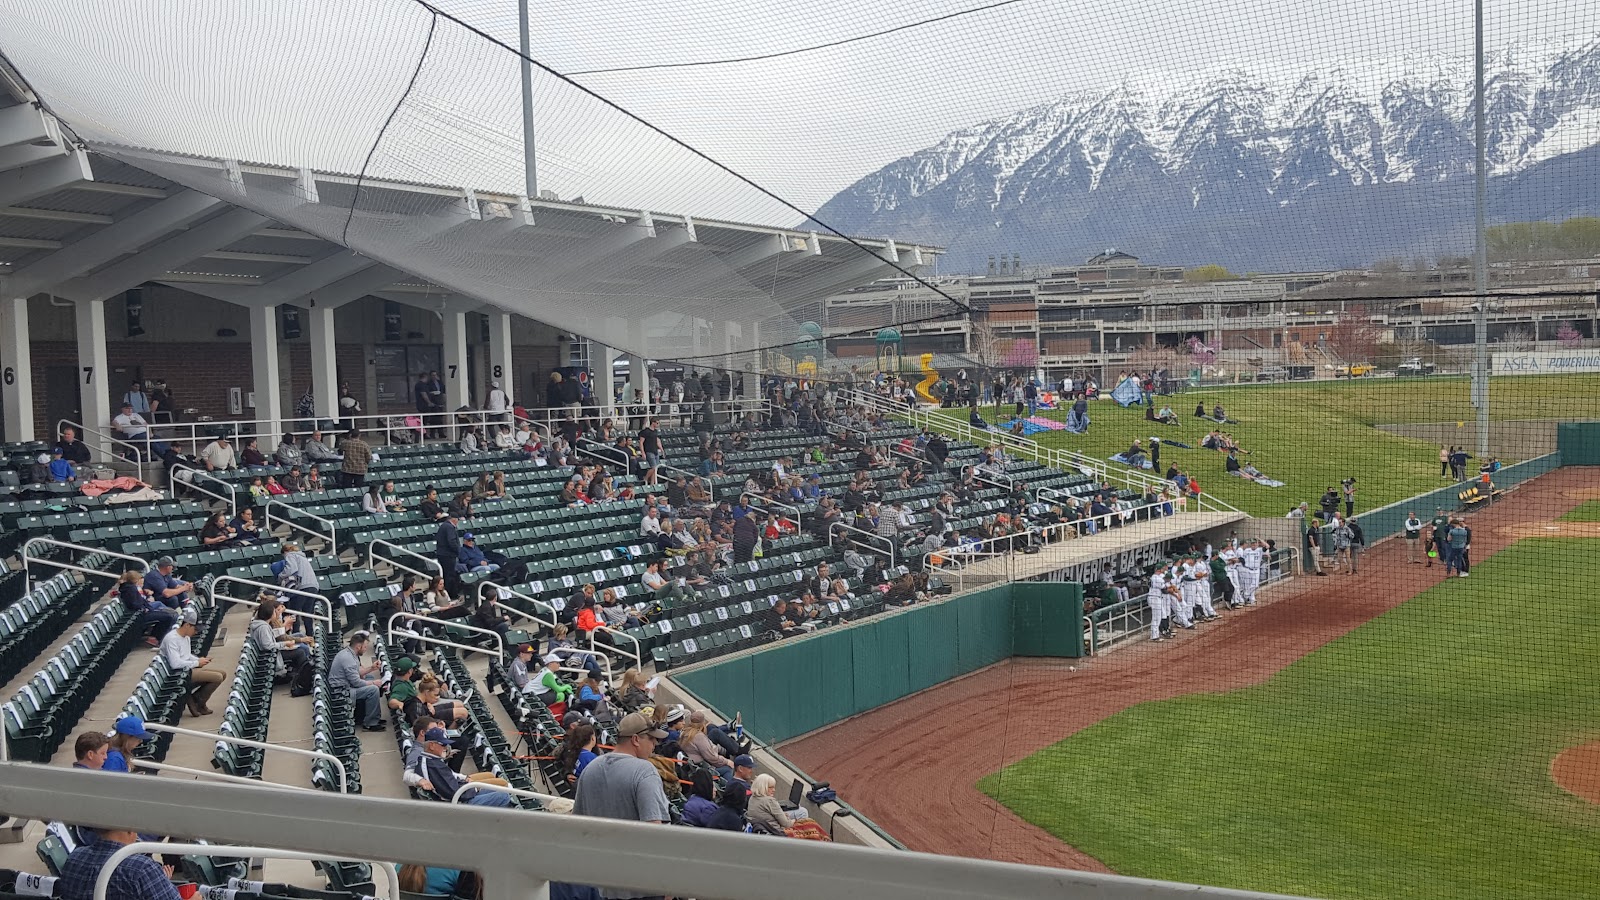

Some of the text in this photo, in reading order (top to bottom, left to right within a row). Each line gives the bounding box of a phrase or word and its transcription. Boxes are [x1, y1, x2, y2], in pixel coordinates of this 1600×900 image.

[1503, 356, 1600, 371] ASEA POWERING
[4, 367, 15, 386] 6
[83, 366, 94, 385] 7
[449, 365, 458, 379] 7
[493, 365, 503, 378] 8
